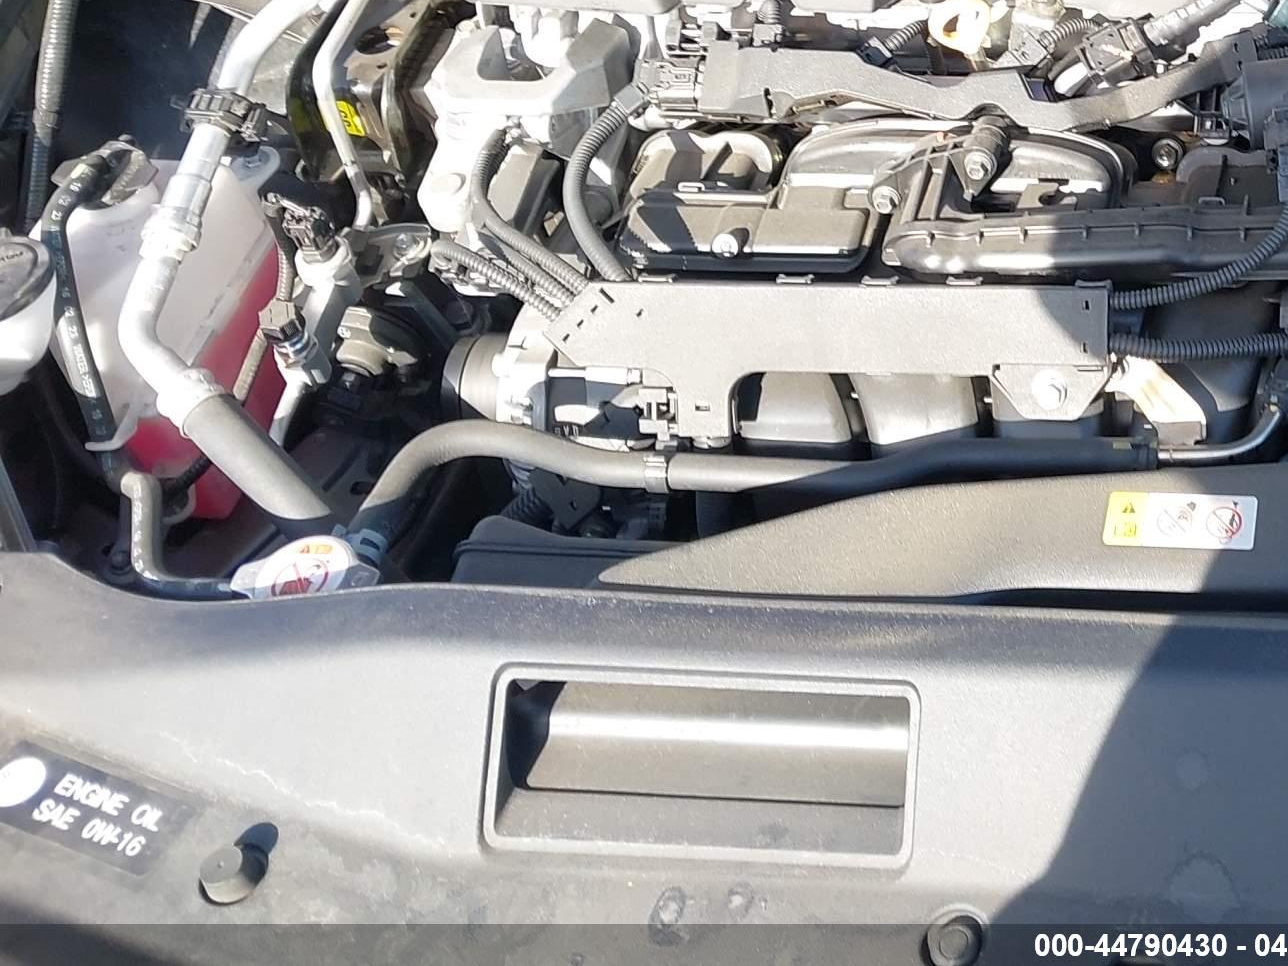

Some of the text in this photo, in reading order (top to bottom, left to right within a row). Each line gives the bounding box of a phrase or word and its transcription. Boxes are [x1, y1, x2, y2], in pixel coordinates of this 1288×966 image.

[31, 798, 147, 857] SAE 0W-16
[53, 772, 163, 833] ENGINE OIL
